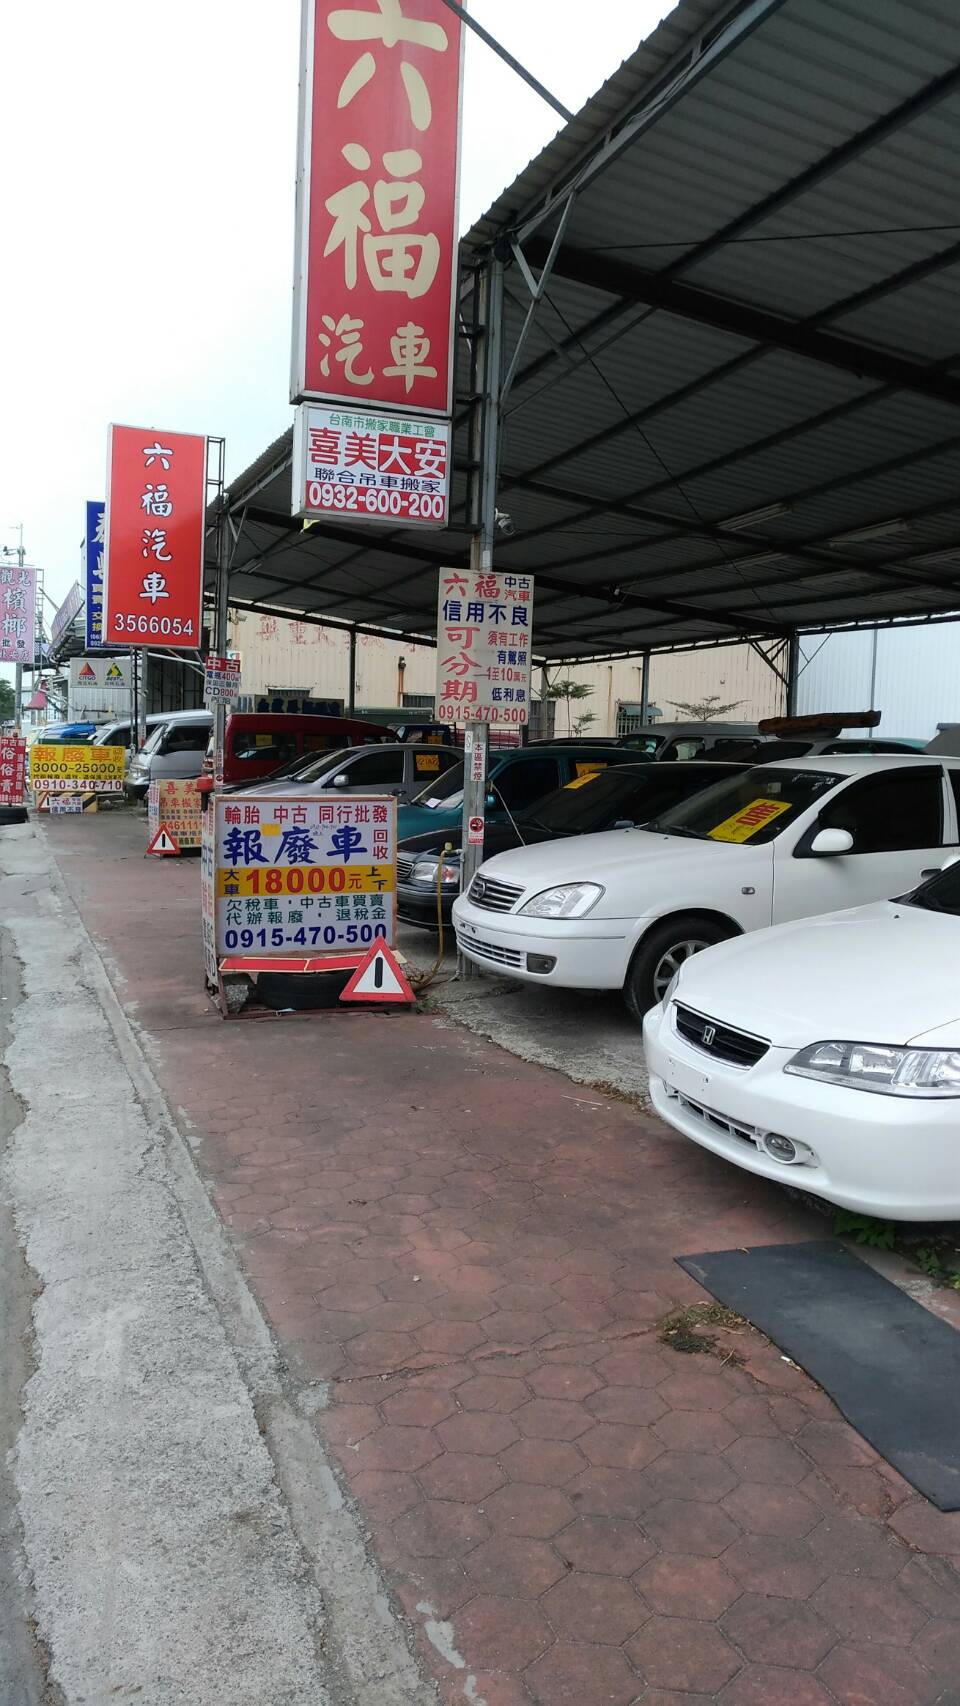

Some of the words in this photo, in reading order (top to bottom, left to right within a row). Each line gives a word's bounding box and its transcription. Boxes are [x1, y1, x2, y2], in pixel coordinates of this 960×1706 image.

[323, 0, 448, 299] 六福
[318, 313, 438, 394] 汽車
[329, 413, 436, 438] 台南市搬家職業工會
[308, 427, 447, 480] 喜美大安
[314, 467, 441, 494] 聯合吊車搬家
[308, 482, 444, 519] 0932-600-200
[139, 442, 174, 605] 六福汽車
[443, 572, 500, 599] 六福
[504, 576, 531, 589] 中古
[504, 589, 531, 602] 汽車
[3, 587, 27, 639] 檳榔
[114, 613, 194, 636] 3566054
[442, 600, 529, 627] 信用不良
[488, 630, 529, 648] 須有工作
[207, 660, 240, 672] 中古
[440, 626, 482, 703] 可分期
[497, 650, 527, 666] 有駕照
[491, 687, 526, 702] 低利息
[438, 704, 526, 722] 0915-470-500
[33, 747, 112, 763] 報廢車
[34, 780, 122, 790] 0910-340-710
[224, 805, 260, 825] 輪胎
[273, 805, 308, 824] 中古
[318, 804, 388, 824] 同行批發
[223, 825, 368, 866] 報廢車
[373, 829, 389, 860] 回收
[223, 869, 240, 896] 大車
[246, 867, 363, 895] 18000元
[224, 923, 387, 949] 0915-470-500
